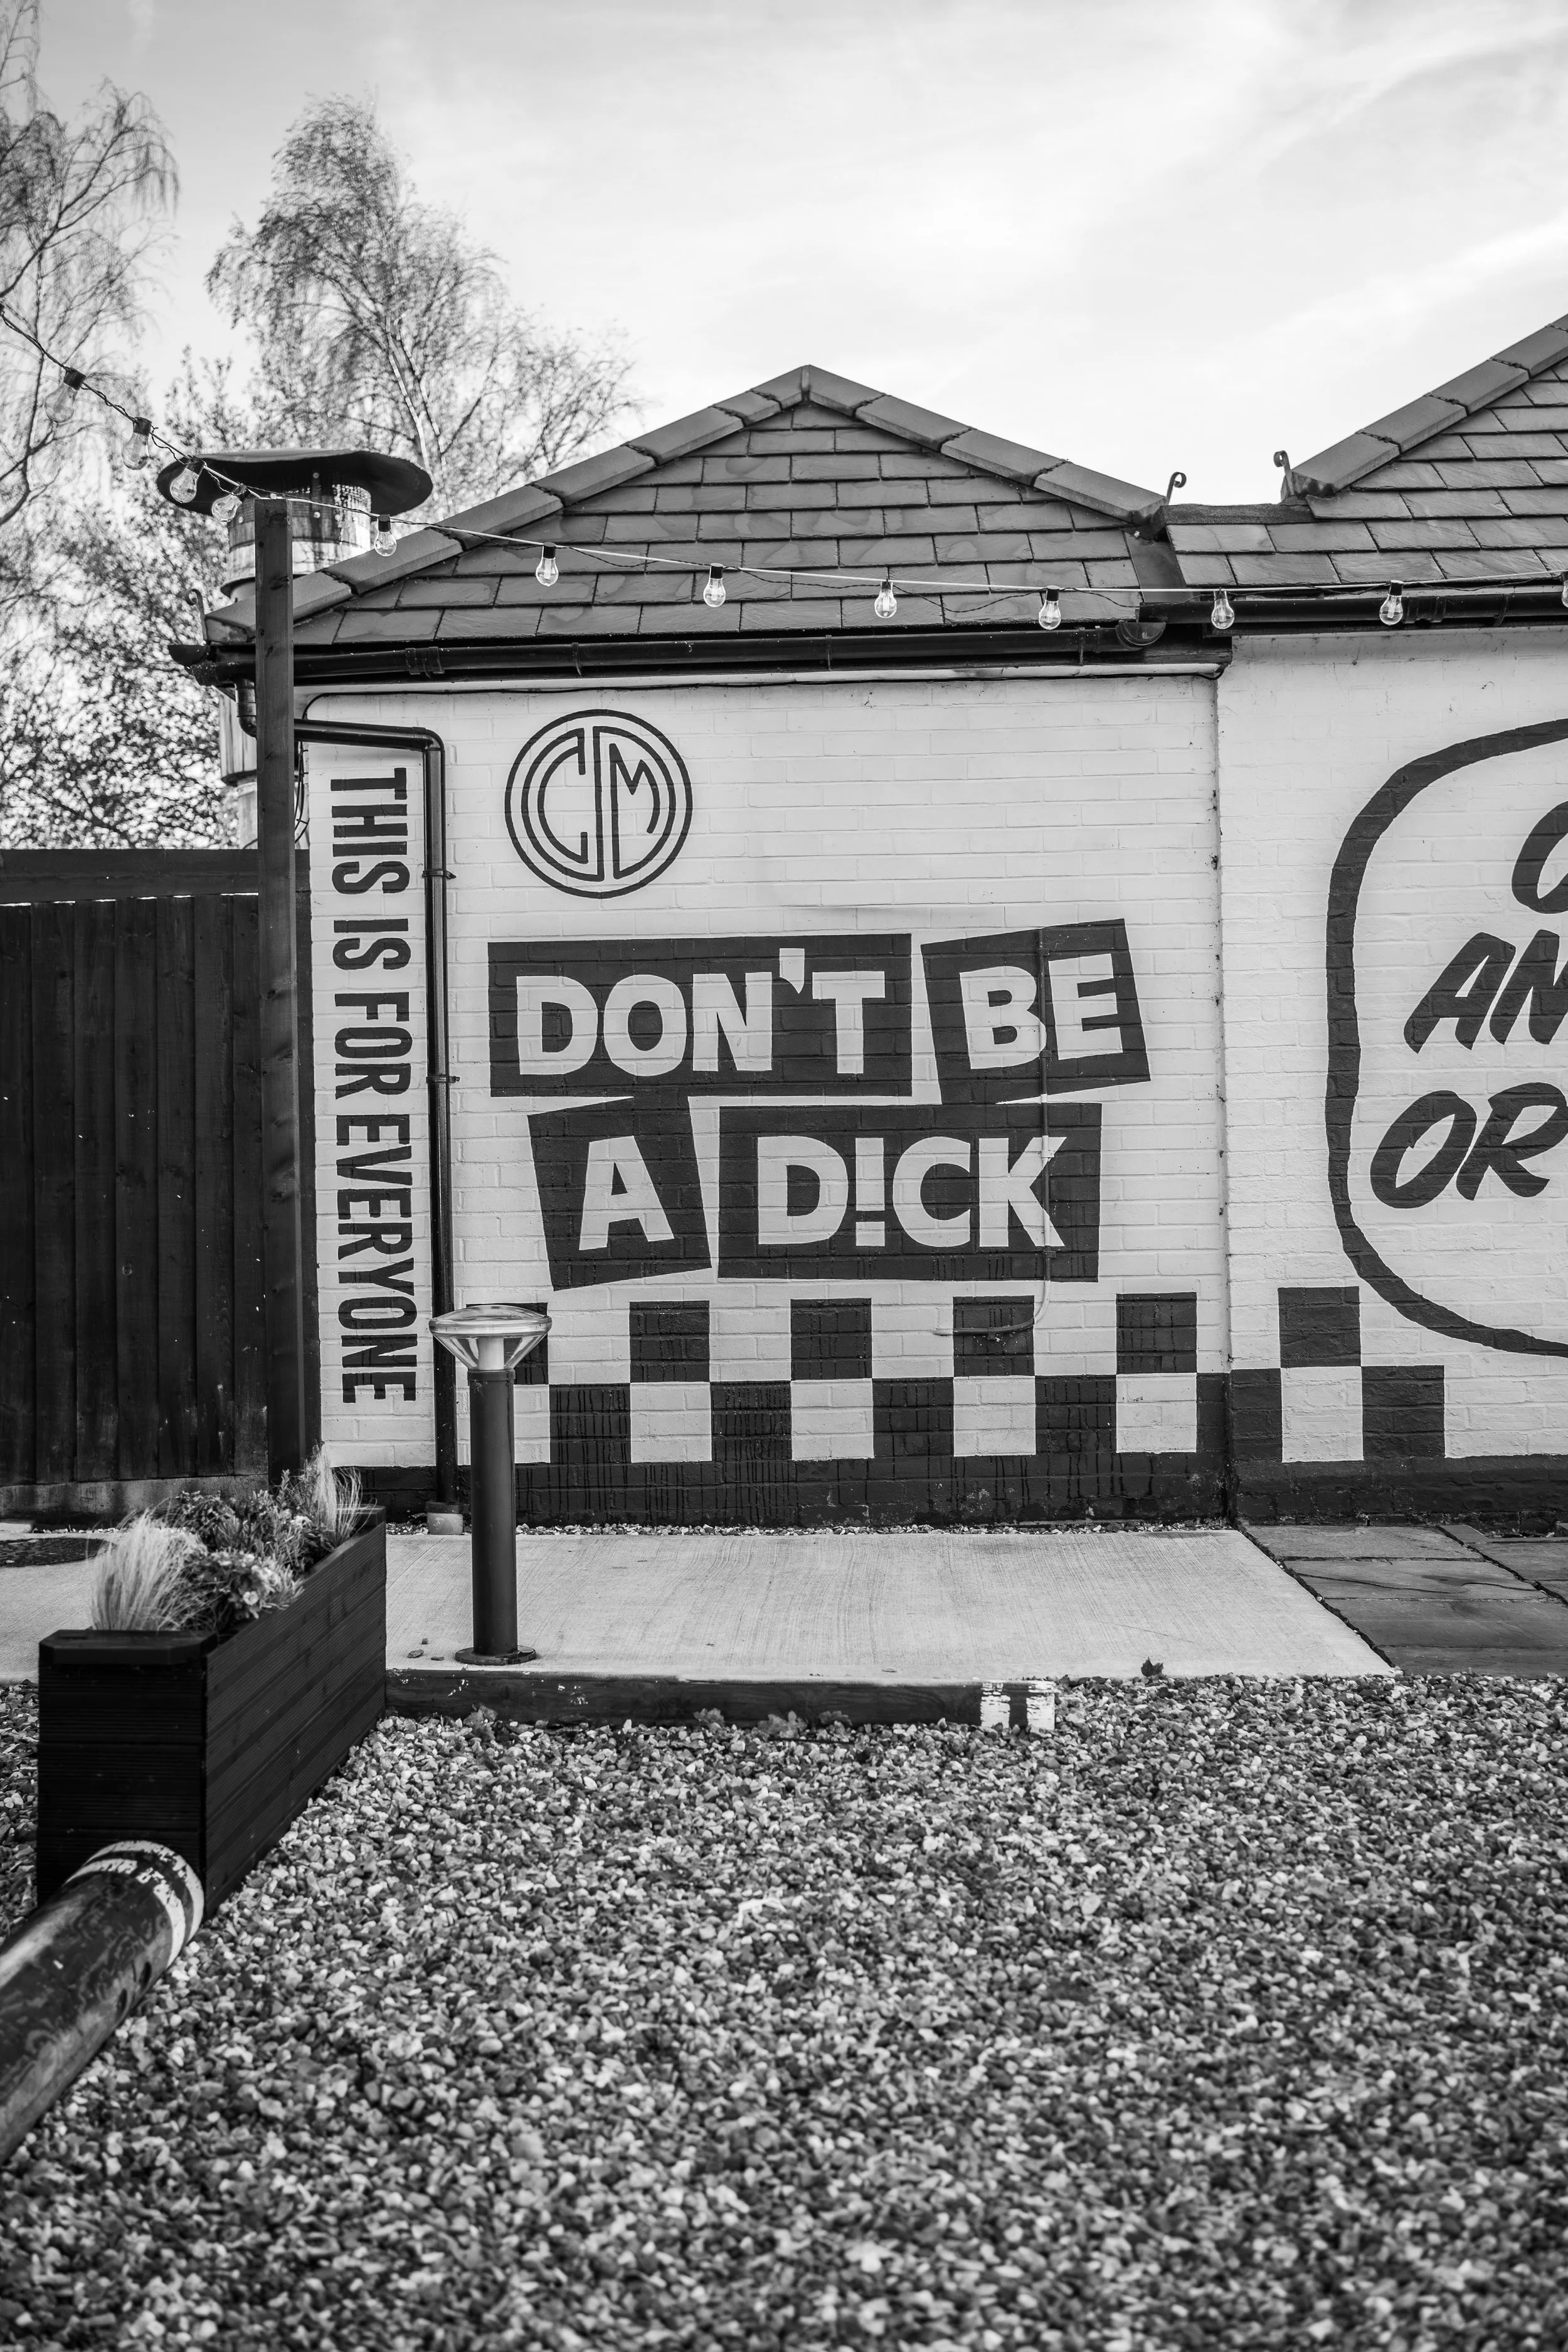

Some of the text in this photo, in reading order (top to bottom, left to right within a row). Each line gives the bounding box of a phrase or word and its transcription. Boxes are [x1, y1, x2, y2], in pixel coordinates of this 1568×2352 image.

[516, 948, 1124, 1077] DON'T BE
[330, 766, 418, 1404] THIS IS FOR EVERYONE
[578, 1135, 675, 1251] A
